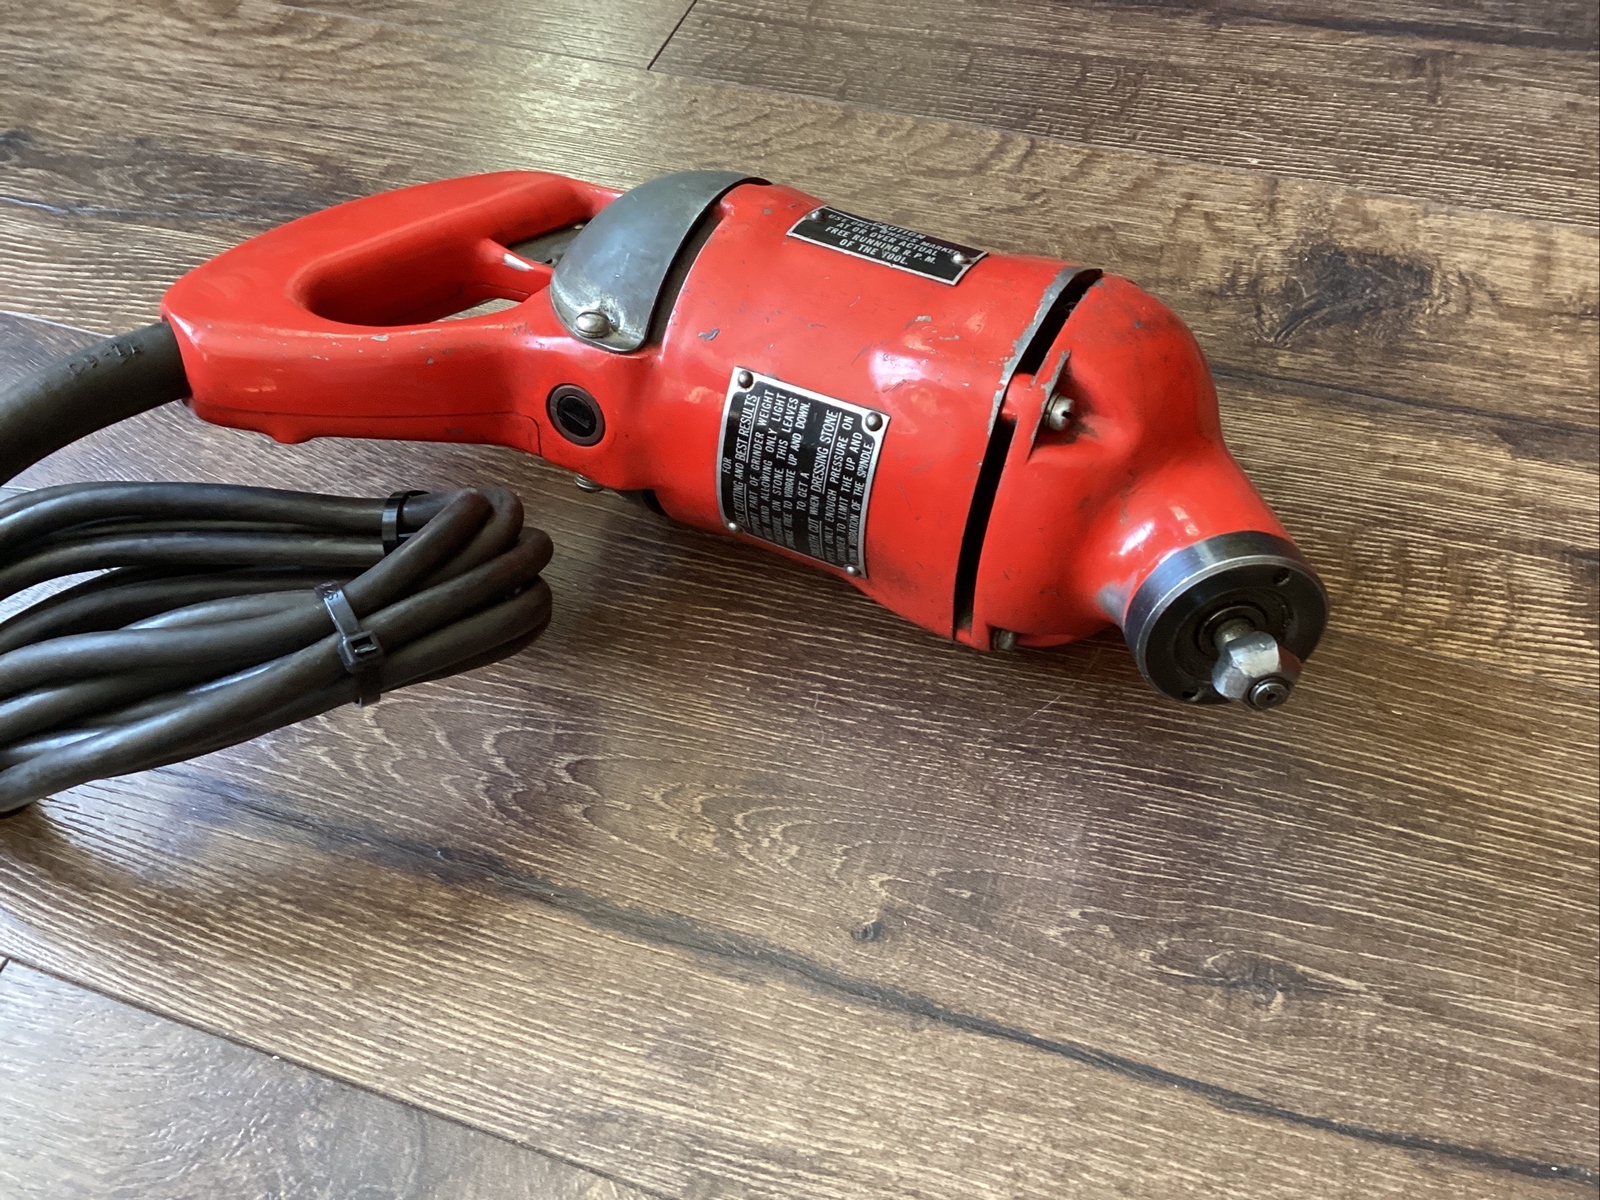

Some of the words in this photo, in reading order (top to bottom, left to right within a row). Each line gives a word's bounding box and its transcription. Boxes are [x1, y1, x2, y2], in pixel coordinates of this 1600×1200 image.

[828, 214, 848, 222] USE
[851, 220, 878, 232] ONLY
[880, 229, 919, 244] WHEELS
[872, 222, 926, 240] CAUTION
[825, 226, 851, 238] FREE
[852, 234, 900, 252] RUNNING
[902, 250, 912, 258] R.
[924, 256, 936, 264] M.
[839, 239, 856, 248] OF
[858, 244, 879, 256] THE
[882, 251, 908, 265] TOOL.
[869, 232, 897, 244] OVER
[898, 241, 938, 256] ACTUAL
[739, 394, 757, 437] RESULTS
[758, 390, 774, 427] WEIGHT
[772, 393, 786, 422] LIGHT
[795, 400, 810, 430] DOWN.
[820, 409, 839, 445] STONE
[841, 415, 854, 431] ON
[736, 438, 748, 462] BEST
[751, 431, 764, 471] GRINDER
[765, 428, 777, 453] ONLY
[790, 432, 802, 452] AND
[849, 431, 862, 453] AND
[722, 457, 732, 474] FOR
[771, 500, 780, 512] ON
[776, 439, 788, 460] THIS
[782, 397, 798, 433] LEAVES
[788, 453, 798, 466] UP
[830, 435, 848, 484] PRESSURE
[845, 457, 856, 471] UP
[734, 462, 744, 480] AND
[761, 459, 772, 502] ALLOWING
[800, 471, 810, 479] A
[811, 446, 829, 493] DRESSING
[750, 475, 758, 487] OF
[784, 469, 796, 500] VIBRATE
[799, 480, 808, 498] GET
[841, 475, 852, 493] THE
[853, 479, 865, 497] THE
[733, 480, 745, 513] CUTTING
[750, 491, 758, 510] PART
[784, 500, 792, 510] TO
[797, 500, 806, 512] TO
[809, 494, 819, 516] WHEN
[825, 489, 837, 523] ENOUGH
[851, 499, 861, 511] OF
[838, 496, 848, 520] LIMIT
[808, 517, 818, 533] CUT
[824, 525, 833, 545] ONLY
[837, 522, 845, 533] TO
